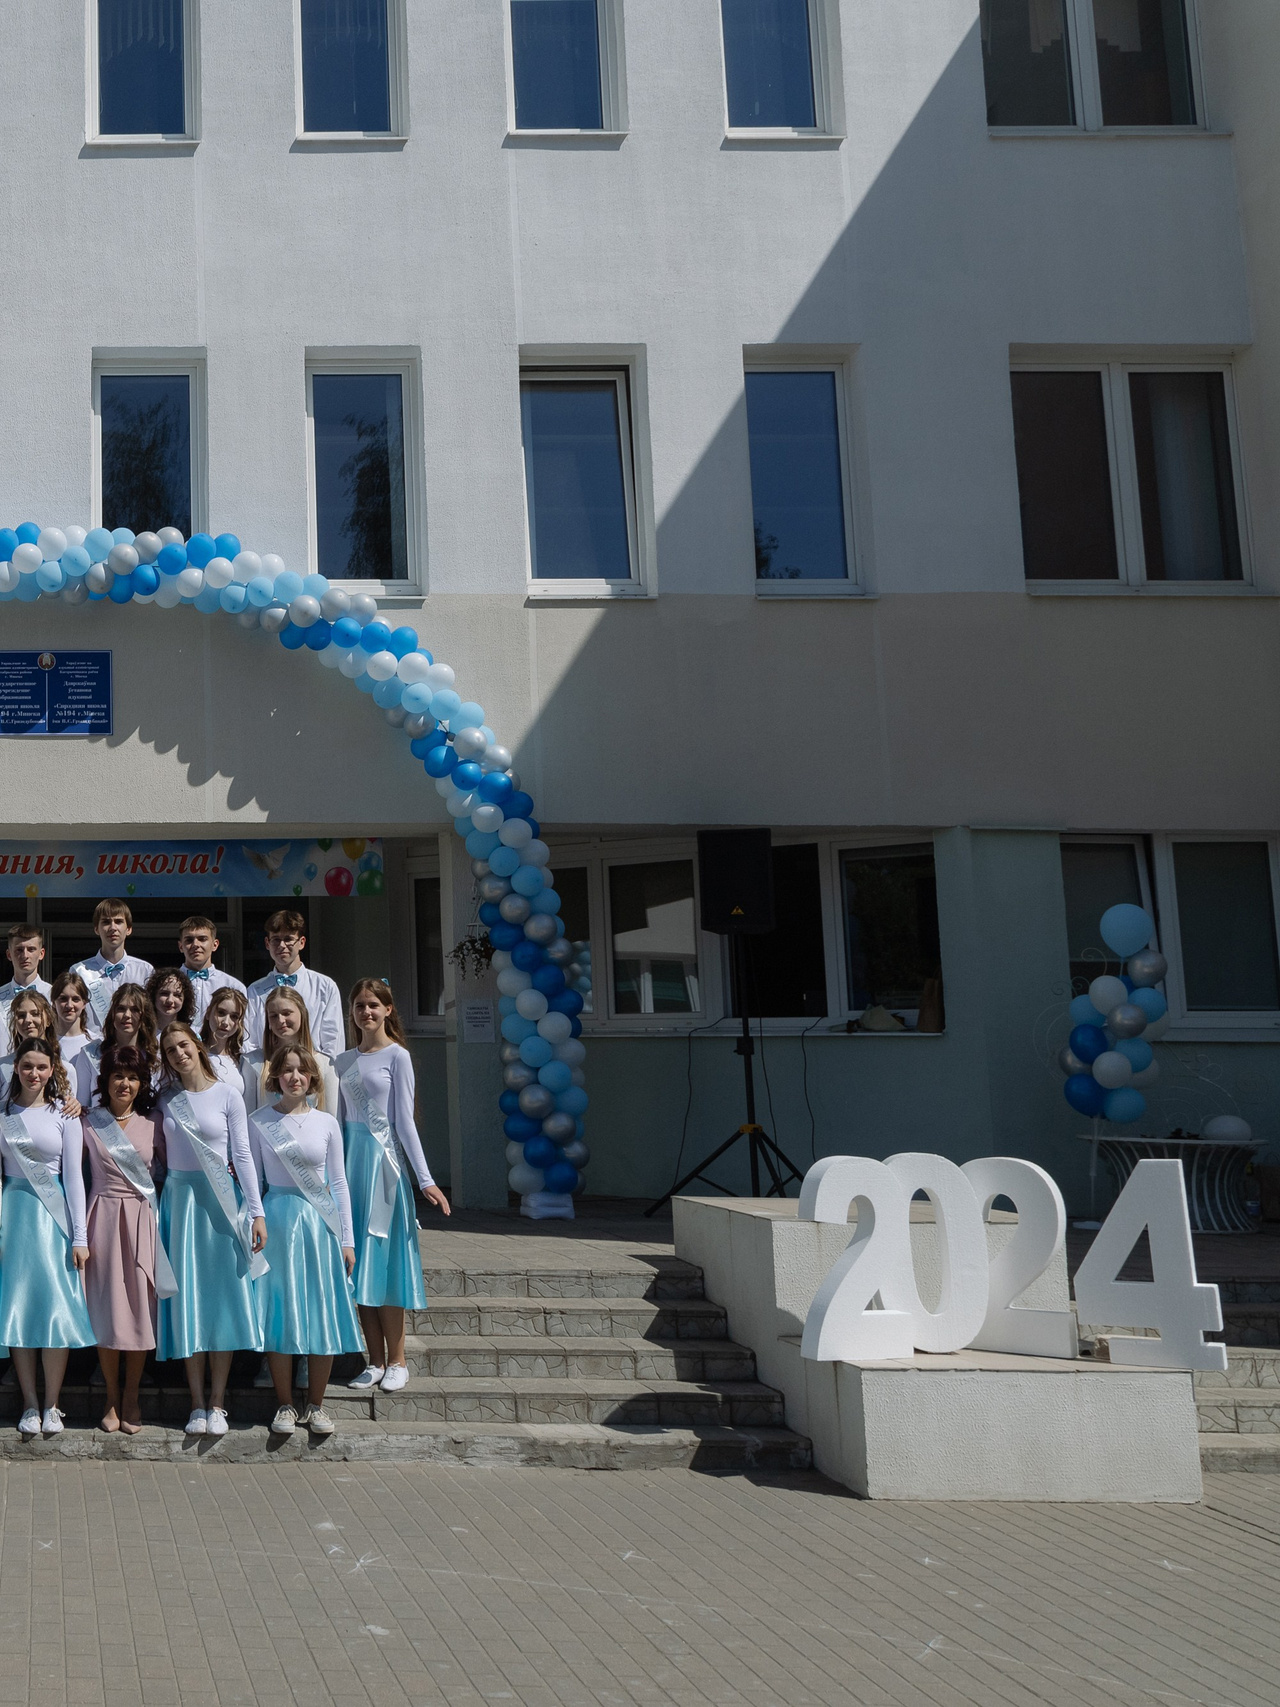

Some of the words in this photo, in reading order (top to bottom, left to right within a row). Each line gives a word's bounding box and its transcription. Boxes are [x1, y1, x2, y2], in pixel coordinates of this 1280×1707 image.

[97, 846, 225, 874] школа!
[33, 1168, 57, 1199] 2024
[209, 1163, 230, 1194] 2024
[266, 1119, 316, 1189] Выпускница
[310, 1185, 336, 1217] 2024
[798, 1152, 1228, 1370] 2024
